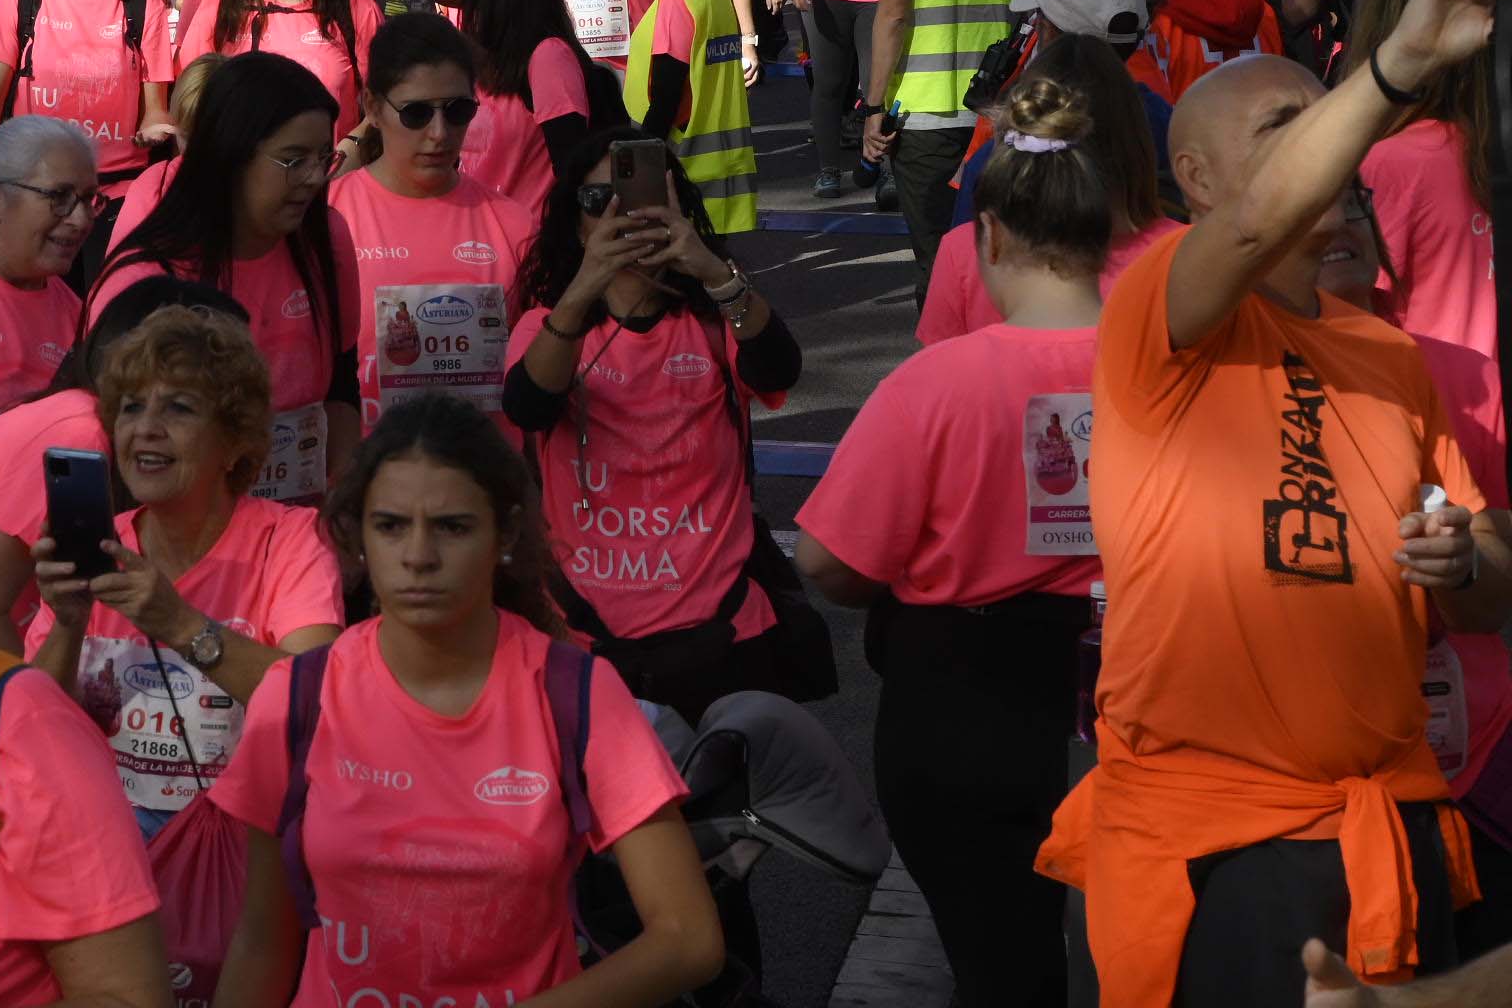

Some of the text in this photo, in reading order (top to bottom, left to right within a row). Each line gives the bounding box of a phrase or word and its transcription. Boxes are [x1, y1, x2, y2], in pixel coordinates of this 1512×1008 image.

[40, 16, 73, 30] OSHO
[578, 17, 603, 28] 016
[32, 87, 57, 108] TU
[421, 306, 470, 318] ASTURIANA
[425, 335, 470, 353] 016
[433, 359, 461, 371] 9986
[573, 503, 712, 537] DORSAL
[1048, 510, 1091, 519] CARRERA
[1043, 531, 1093, 543] OYSHO
[571, 547, 680, 581] SUMA
[127, 708, 185, 737] 016
[130, 739, 178, 758] 21868
[135, 762, 148, 770] DE
[150, 764, 163, 772] LA
[206, 767, 222, 775] 202
[480, 783, 545, 797] ASTURIANA
